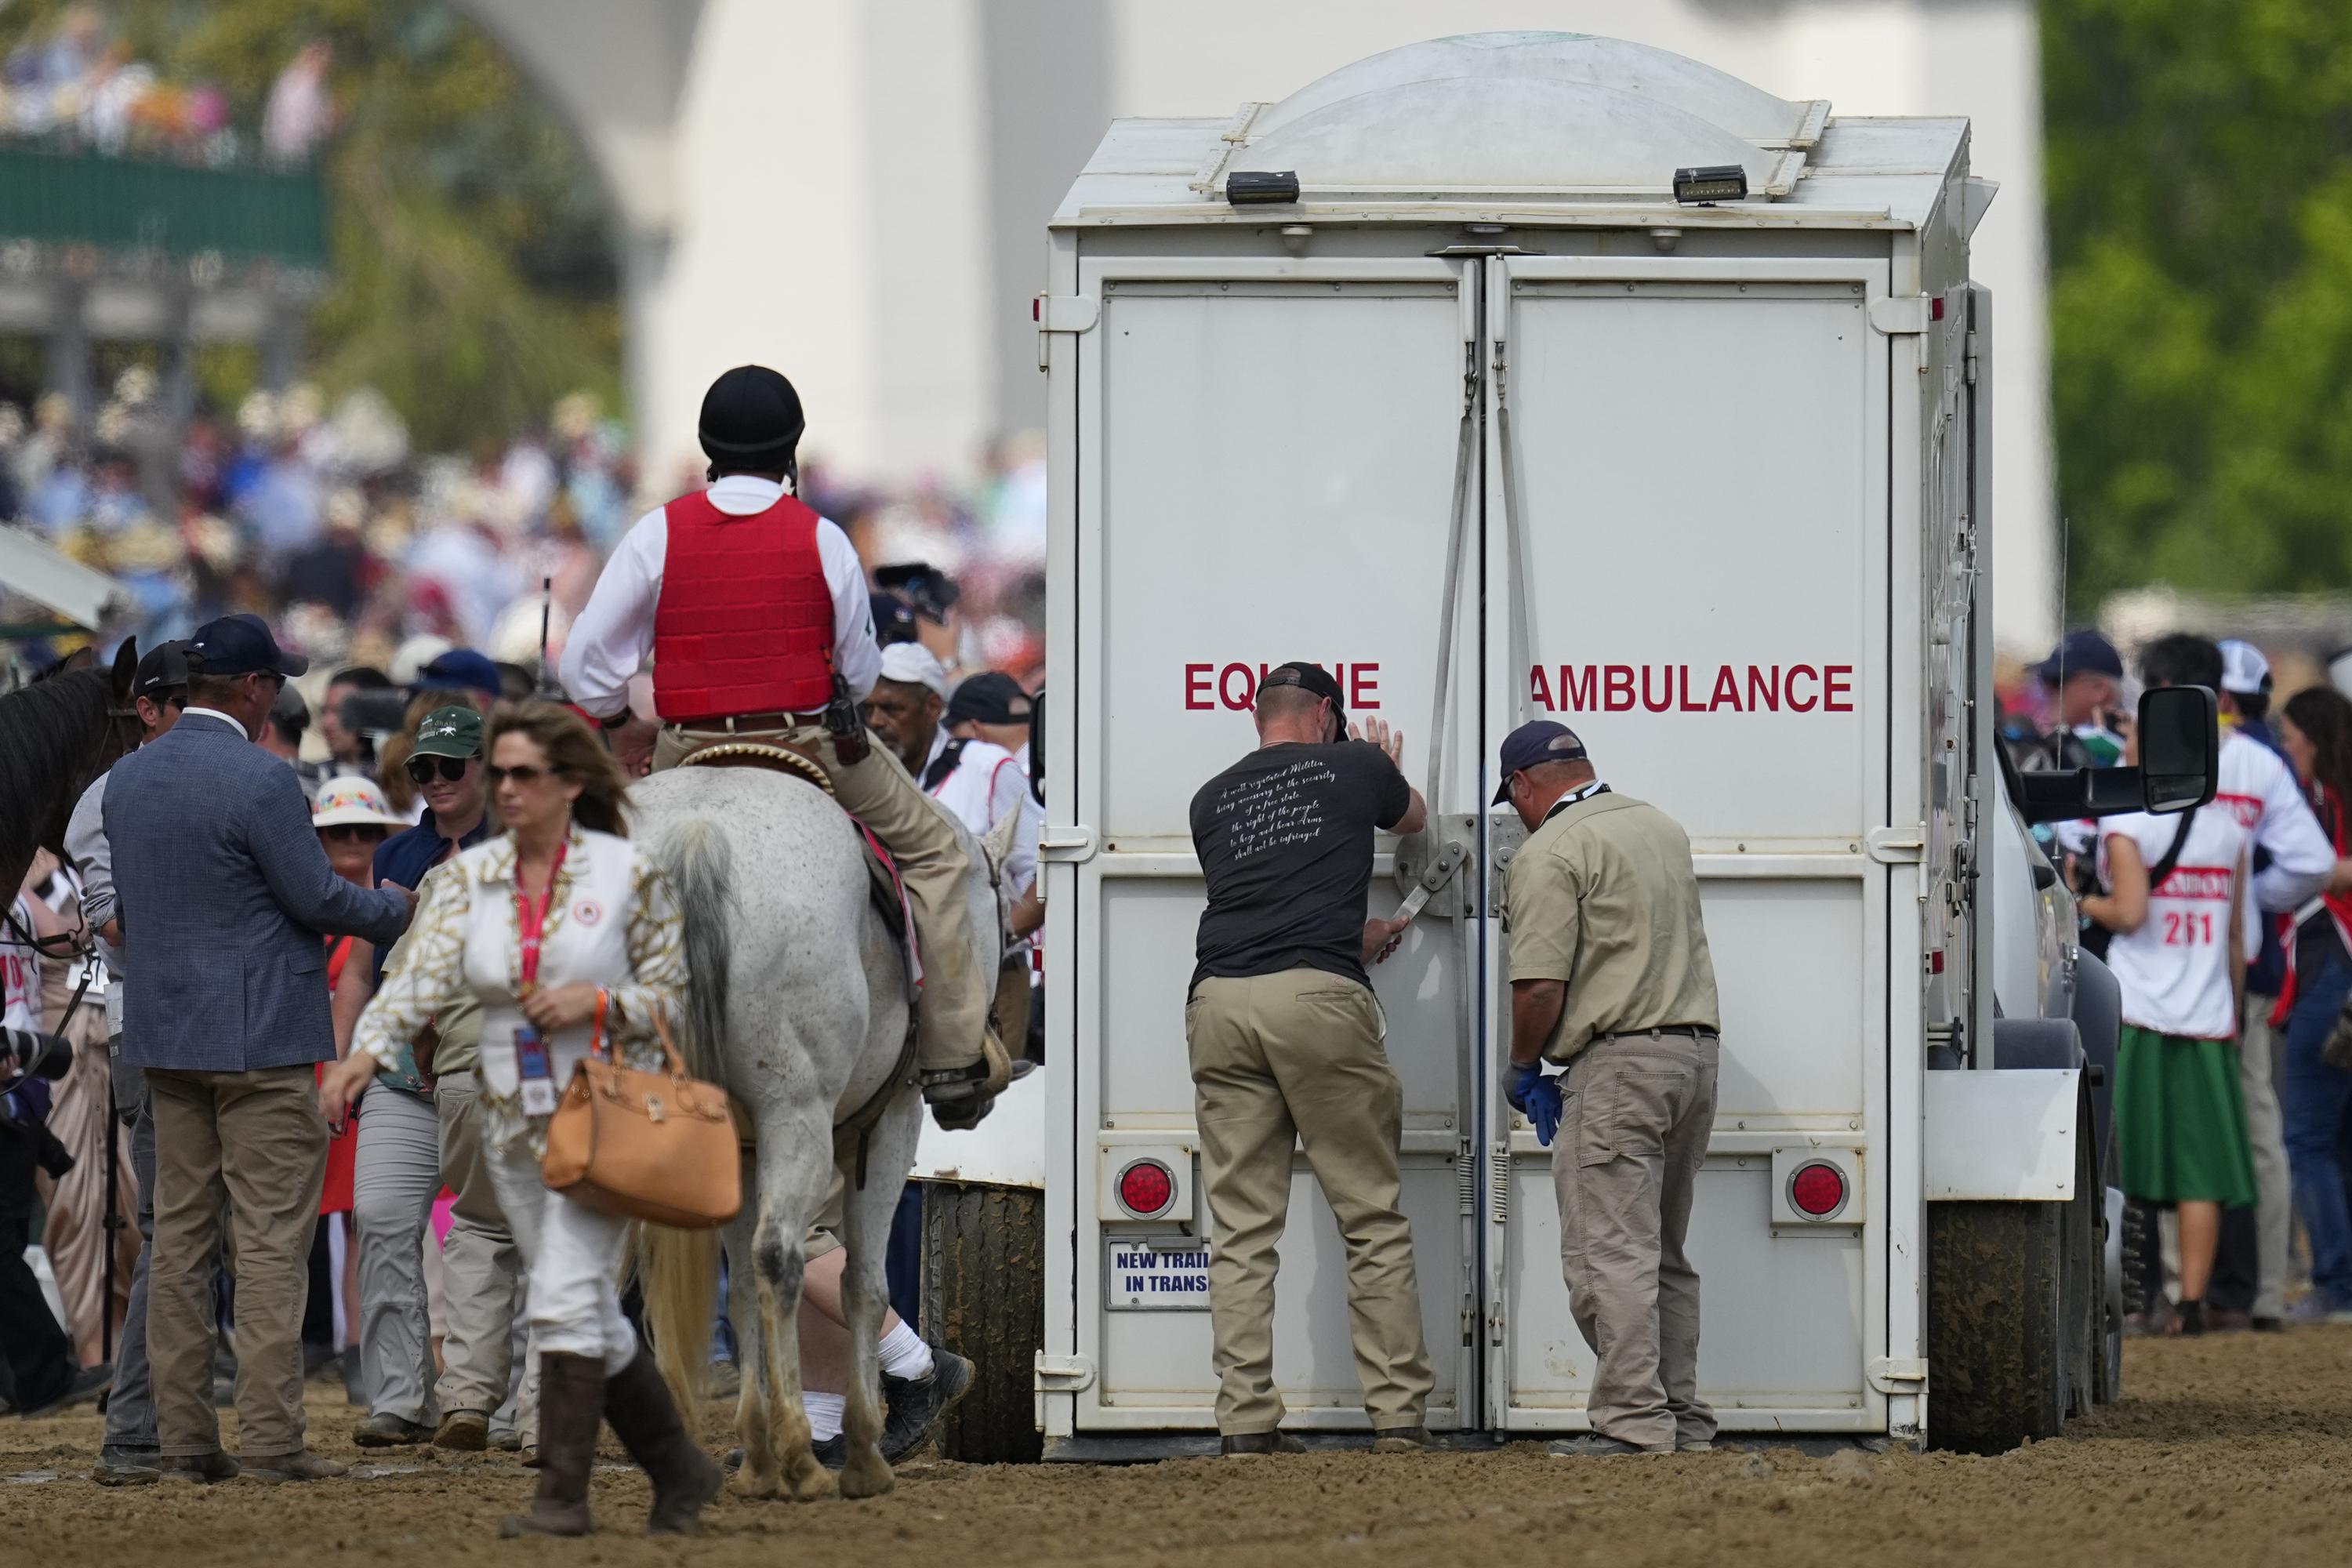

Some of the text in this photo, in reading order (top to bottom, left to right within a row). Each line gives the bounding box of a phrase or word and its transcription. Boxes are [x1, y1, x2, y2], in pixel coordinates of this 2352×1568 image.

[1185, 662, 1853, 713] EQE AMBULANCE
[1216, 801, 1236, 814] being
[1238, 788, 1273, 804] necessary
[1287, 777, 1300, 788] the
[1301, 769, 1335, 782] security
[1231, 821, 1243, 833] the
[1245, 812, 1265, 830] right
[1267, 809, 1276, 822] of
[1278, 805, 1291, 816] the
[1244, 804, 1254, 816] of
[1261, 799, 1278, 811] free
[1230, 838, 1237, 848] to
[1239, 833, 1256, 844] keep
[1258, 822, 1275, 836] and
[1276, 820, 1294, 830] bear
[1235, 844, 1253, 861] shall
[1254, 840, 1266, 853] not
[1269, 836, 1277, 847] be
[1117, 1253, 1157, 1269] NEW
[1126, 1275, 1210, 1292] IN TRANS
